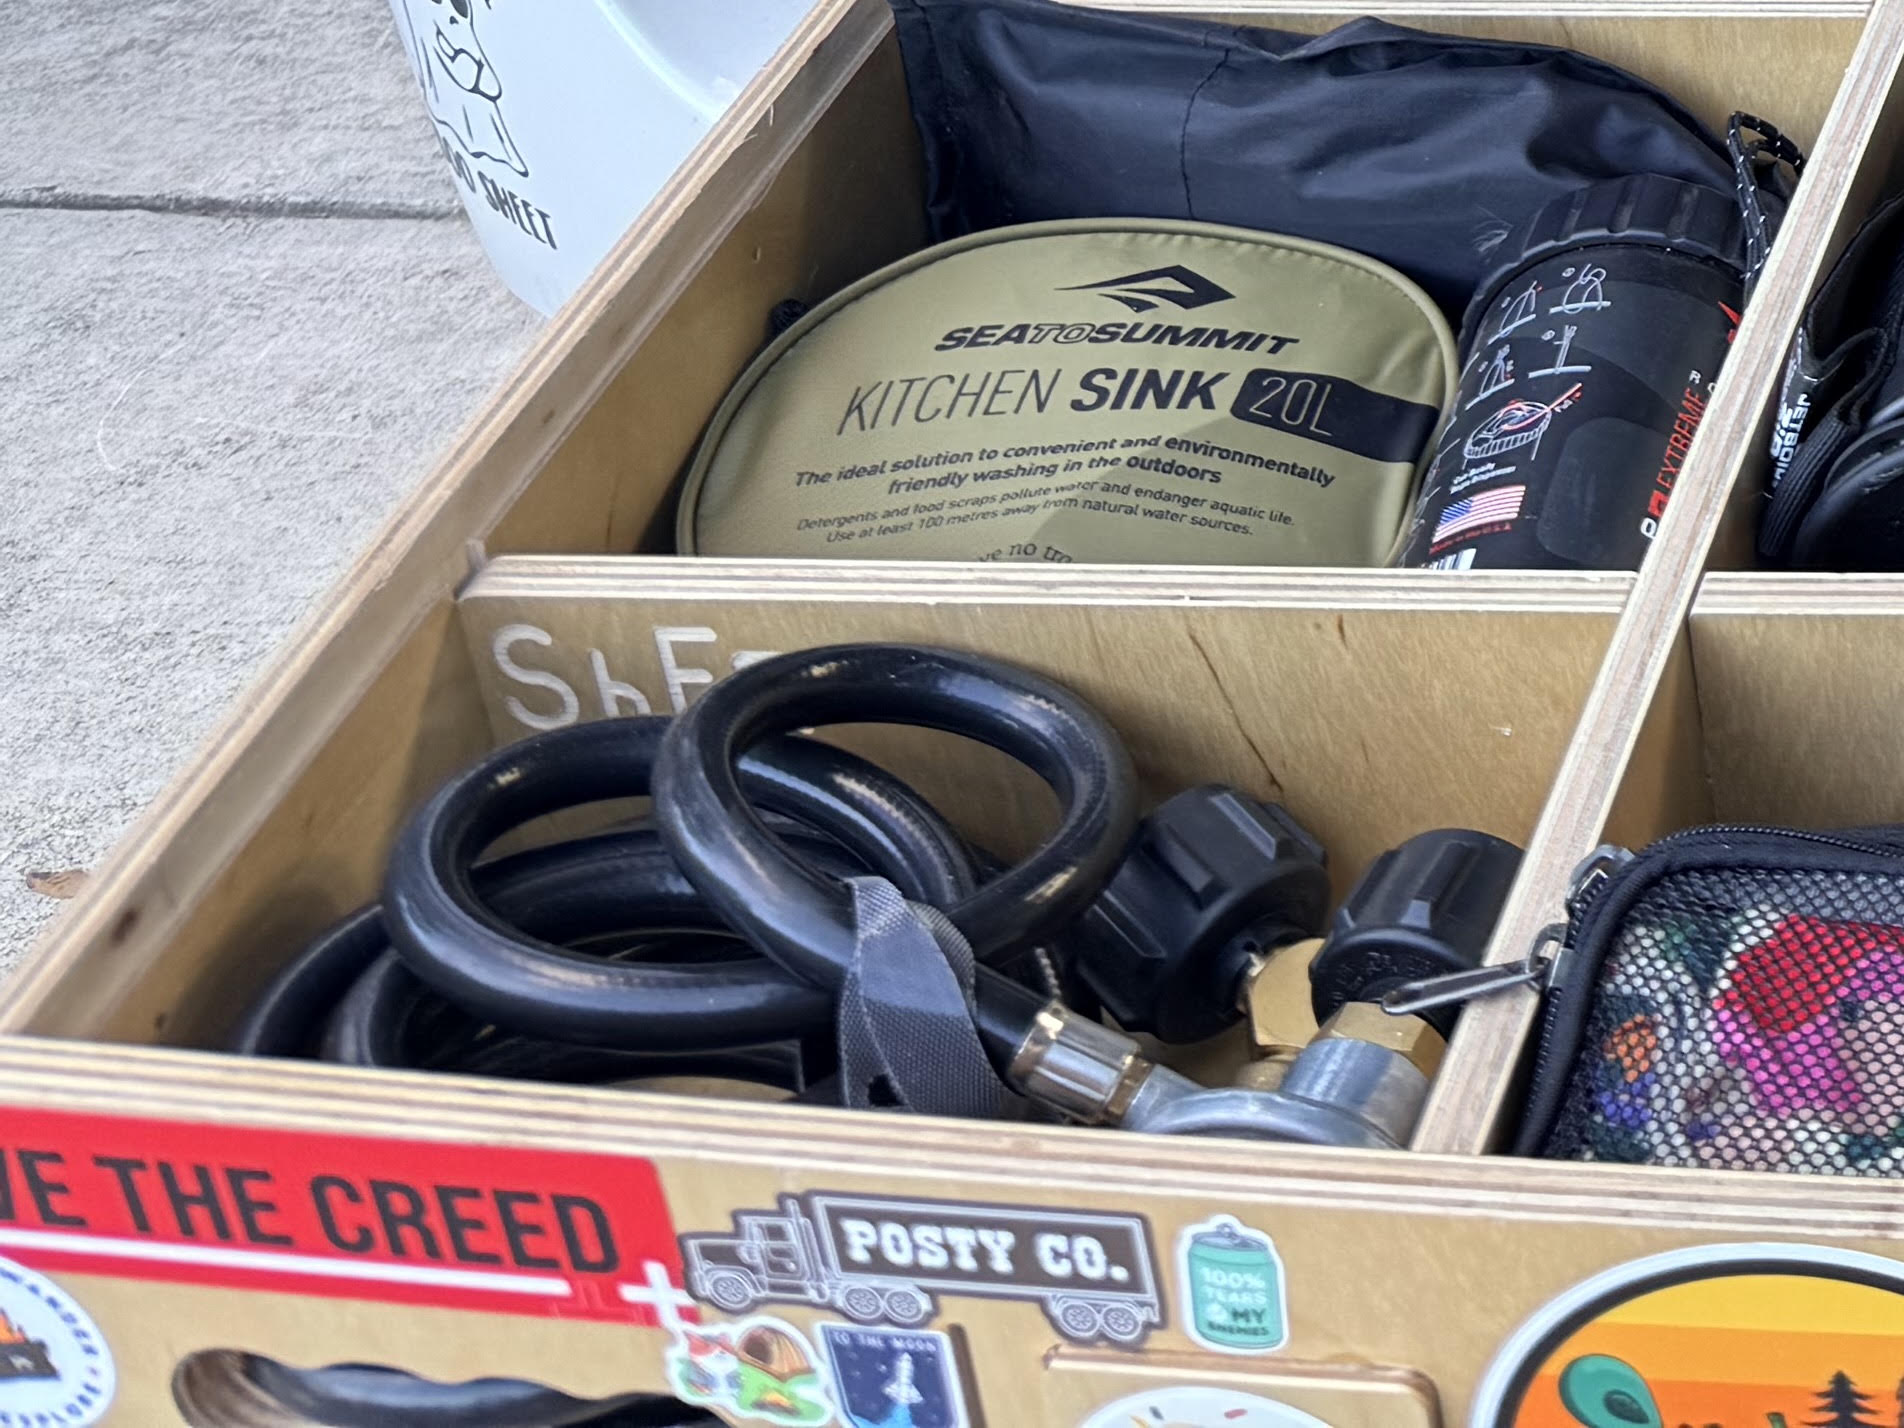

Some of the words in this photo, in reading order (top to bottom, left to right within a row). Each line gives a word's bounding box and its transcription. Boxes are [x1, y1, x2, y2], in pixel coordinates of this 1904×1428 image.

[477, 170, 558, 250] SHEET
[836, 368, 1063, 436] KITCHEN
[1070, 369, 1232, 412] SINK
[1249, 376, 1335, 437] 20L
[795, 472, 832, 488] The
[836, 460, 887, 481] ideal
[891, 450, 973, 473] solution
[978, 446, 998, 462] to
[1002, 437, 1118, 459] convenient
[1120, 435, 1162, 449] and
[1165, 435, 1336, 488] environmentally
[888, 471, 969, 495] friendly
[973, 459, 1058, 484] washing
[1063, 459, 1083, 473] in
[1088, 456, 1122, 469] the
[1126, 455, 1223, 483] outdoors
[827, 530, 852, 543] Use
[858, 528, 874, 539] at
[919, 515, 945, 530] 100
[1001, 502, 1040, 518] away
[1081, 497, 1139, 517] natural
[1142, 505, 1186, 524] water
[1190, 515, 1254, 536] sources.
[882, 505, 910, 520] and
[913, 500, 944, 515] food
[950, 493, 997, 511] scraps
[1000, 485, 1051, 503] pollute
[1101, 477, 1131, 495] and
[1134, 484, 1208, 508] endanger
[1210, 499, 1265, 520] aquatic
[1007, 543, 1037, 557] no
[94, 1155, 294, 1247] THE
[309, 1174, 621, 1275] CREED
[841, 1217, 1016, 1275] POSTY
[1034, 1232, 1130, 1283] CO.
[1200, 1266, 1266, 1291] 100%
[1204, 1286, 1267, 1307] TEARS
[1231, 1307, 1268, 1324] MY
